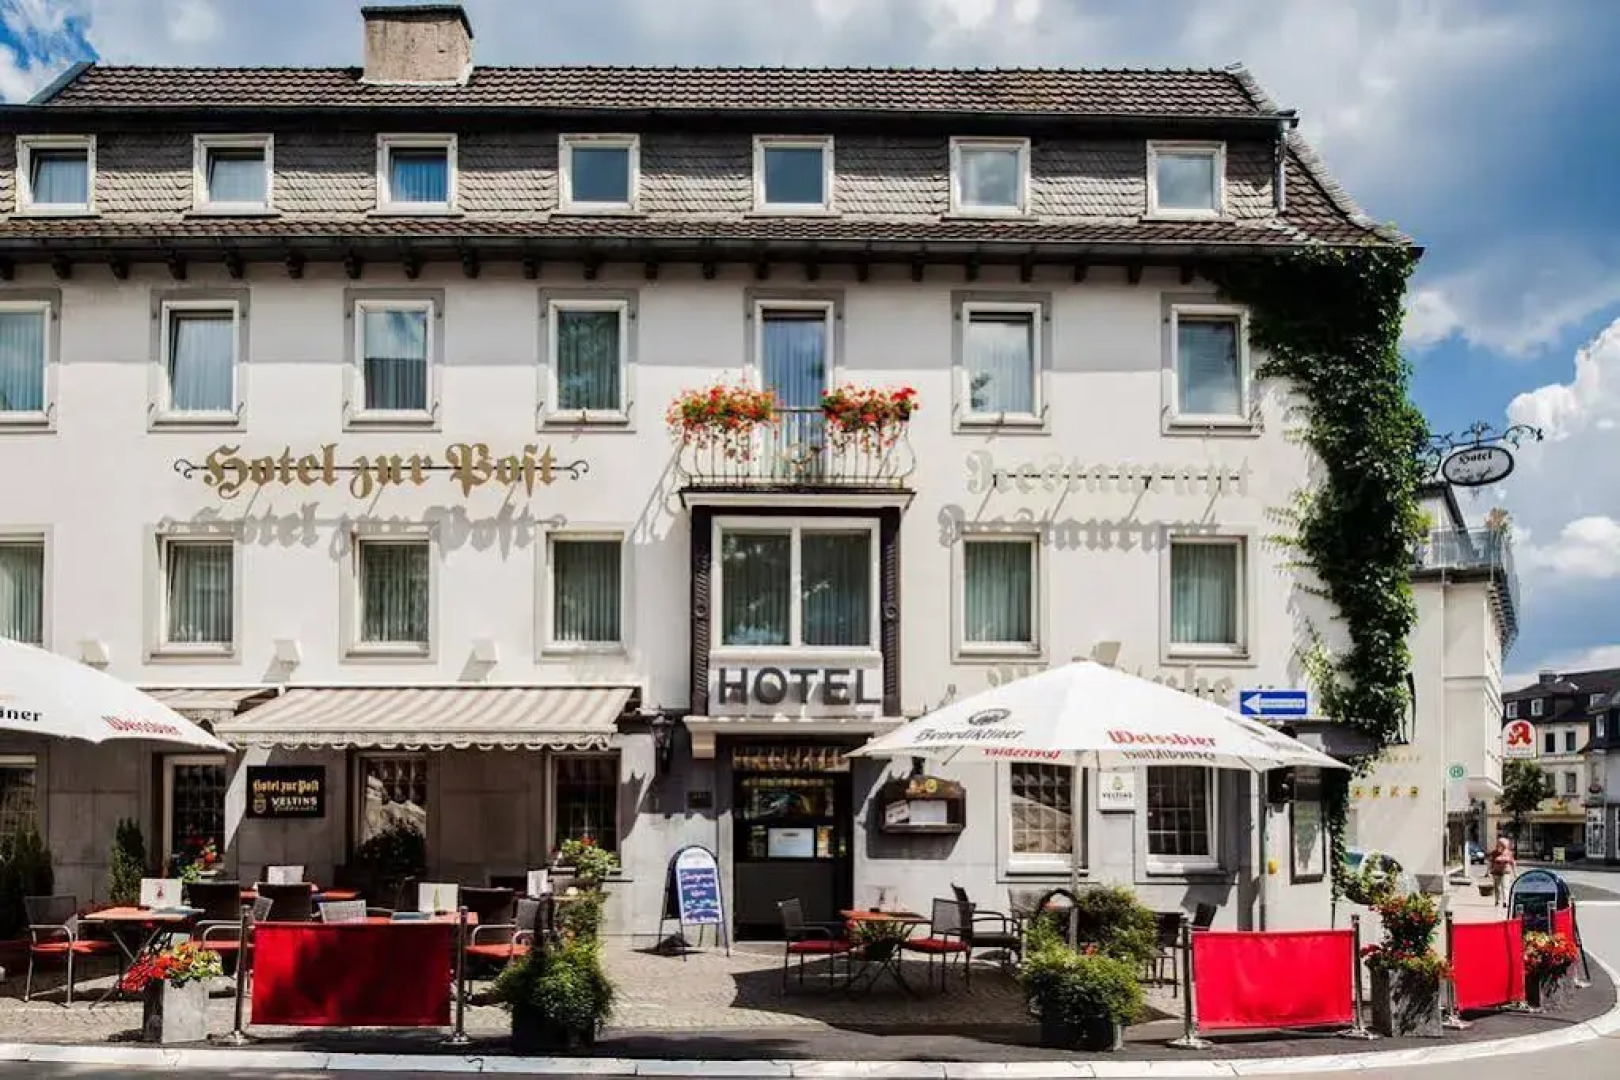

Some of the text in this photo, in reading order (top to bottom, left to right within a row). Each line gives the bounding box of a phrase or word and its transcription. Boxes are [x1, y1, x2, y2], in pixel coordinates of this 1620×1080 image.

[203, 443, 338, 499] Hotel
[350, 455, 432, 499] zur
[719, 667, 881, 705] HOTEL
[1106, 729, 1216, 747] Weissbier
[271, 796, 318, 806] VELTINS
